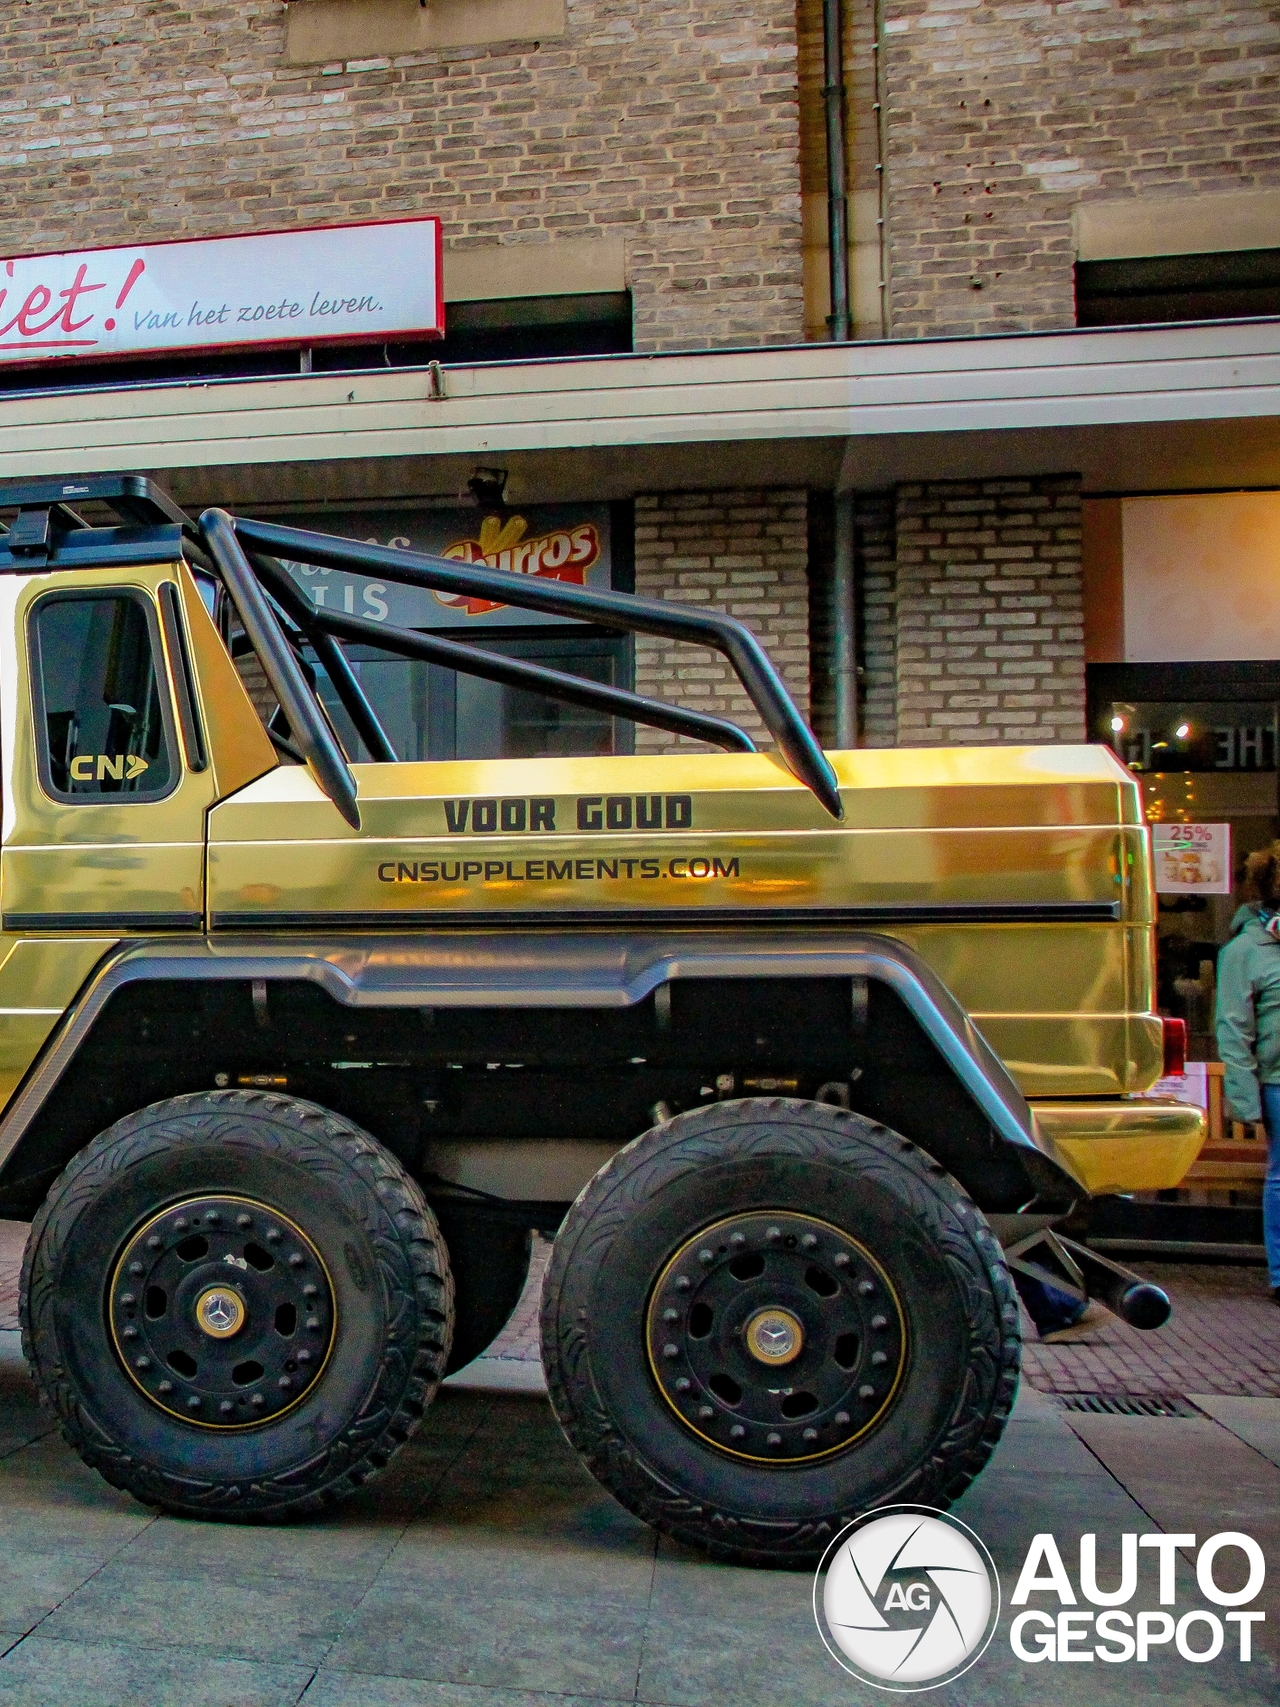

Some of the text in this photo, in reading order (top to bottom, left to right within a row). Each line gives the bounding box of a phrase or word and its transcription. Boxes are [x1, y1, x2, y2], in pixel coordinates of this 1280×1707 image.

[187, 301, 231, 326] het
[237, 302, 304, 322] zoete
[309, 291, 384, 317] leven.
[444, 794, 692, 832] VOOR GOUD
[1170, 825, 1213, 841] 25%
[378, 857, 740, 882] CNSUPPLEMENTS.COM
